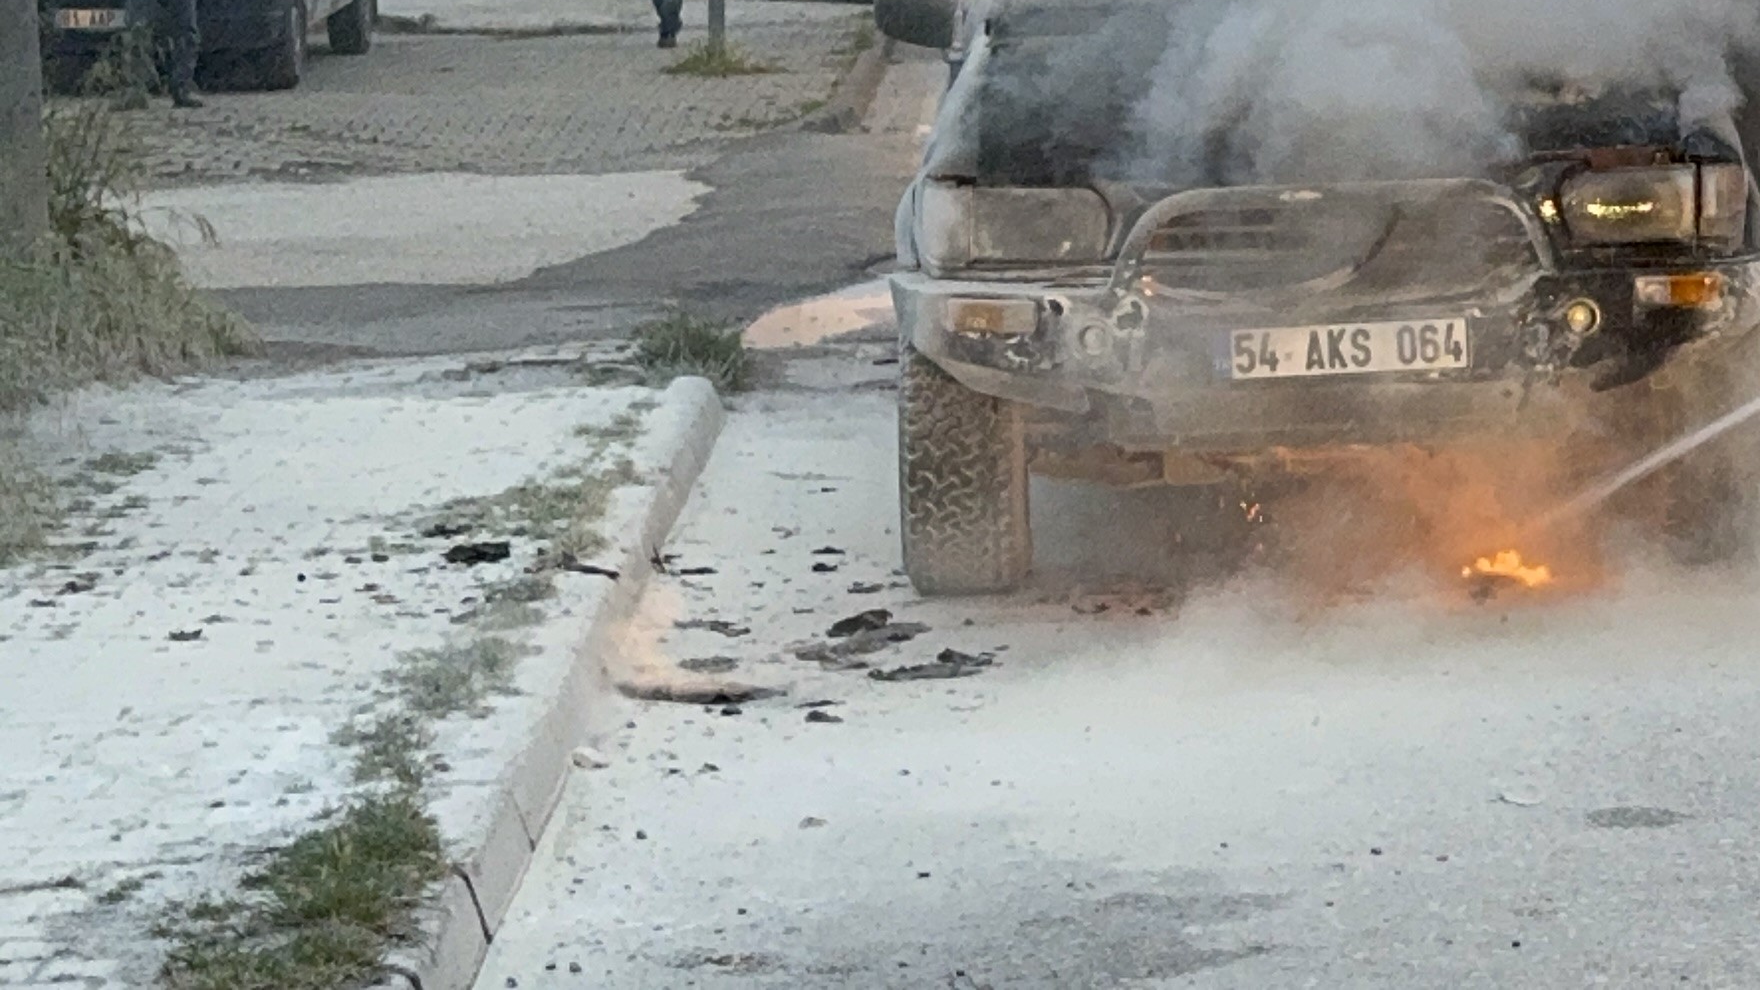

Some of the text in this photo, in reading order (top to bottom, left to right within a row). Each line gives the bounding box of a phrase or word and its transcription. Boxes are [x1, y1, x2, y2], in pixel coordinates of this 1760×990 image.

[1233, 322, 1464, 375] 54 AKS 064
